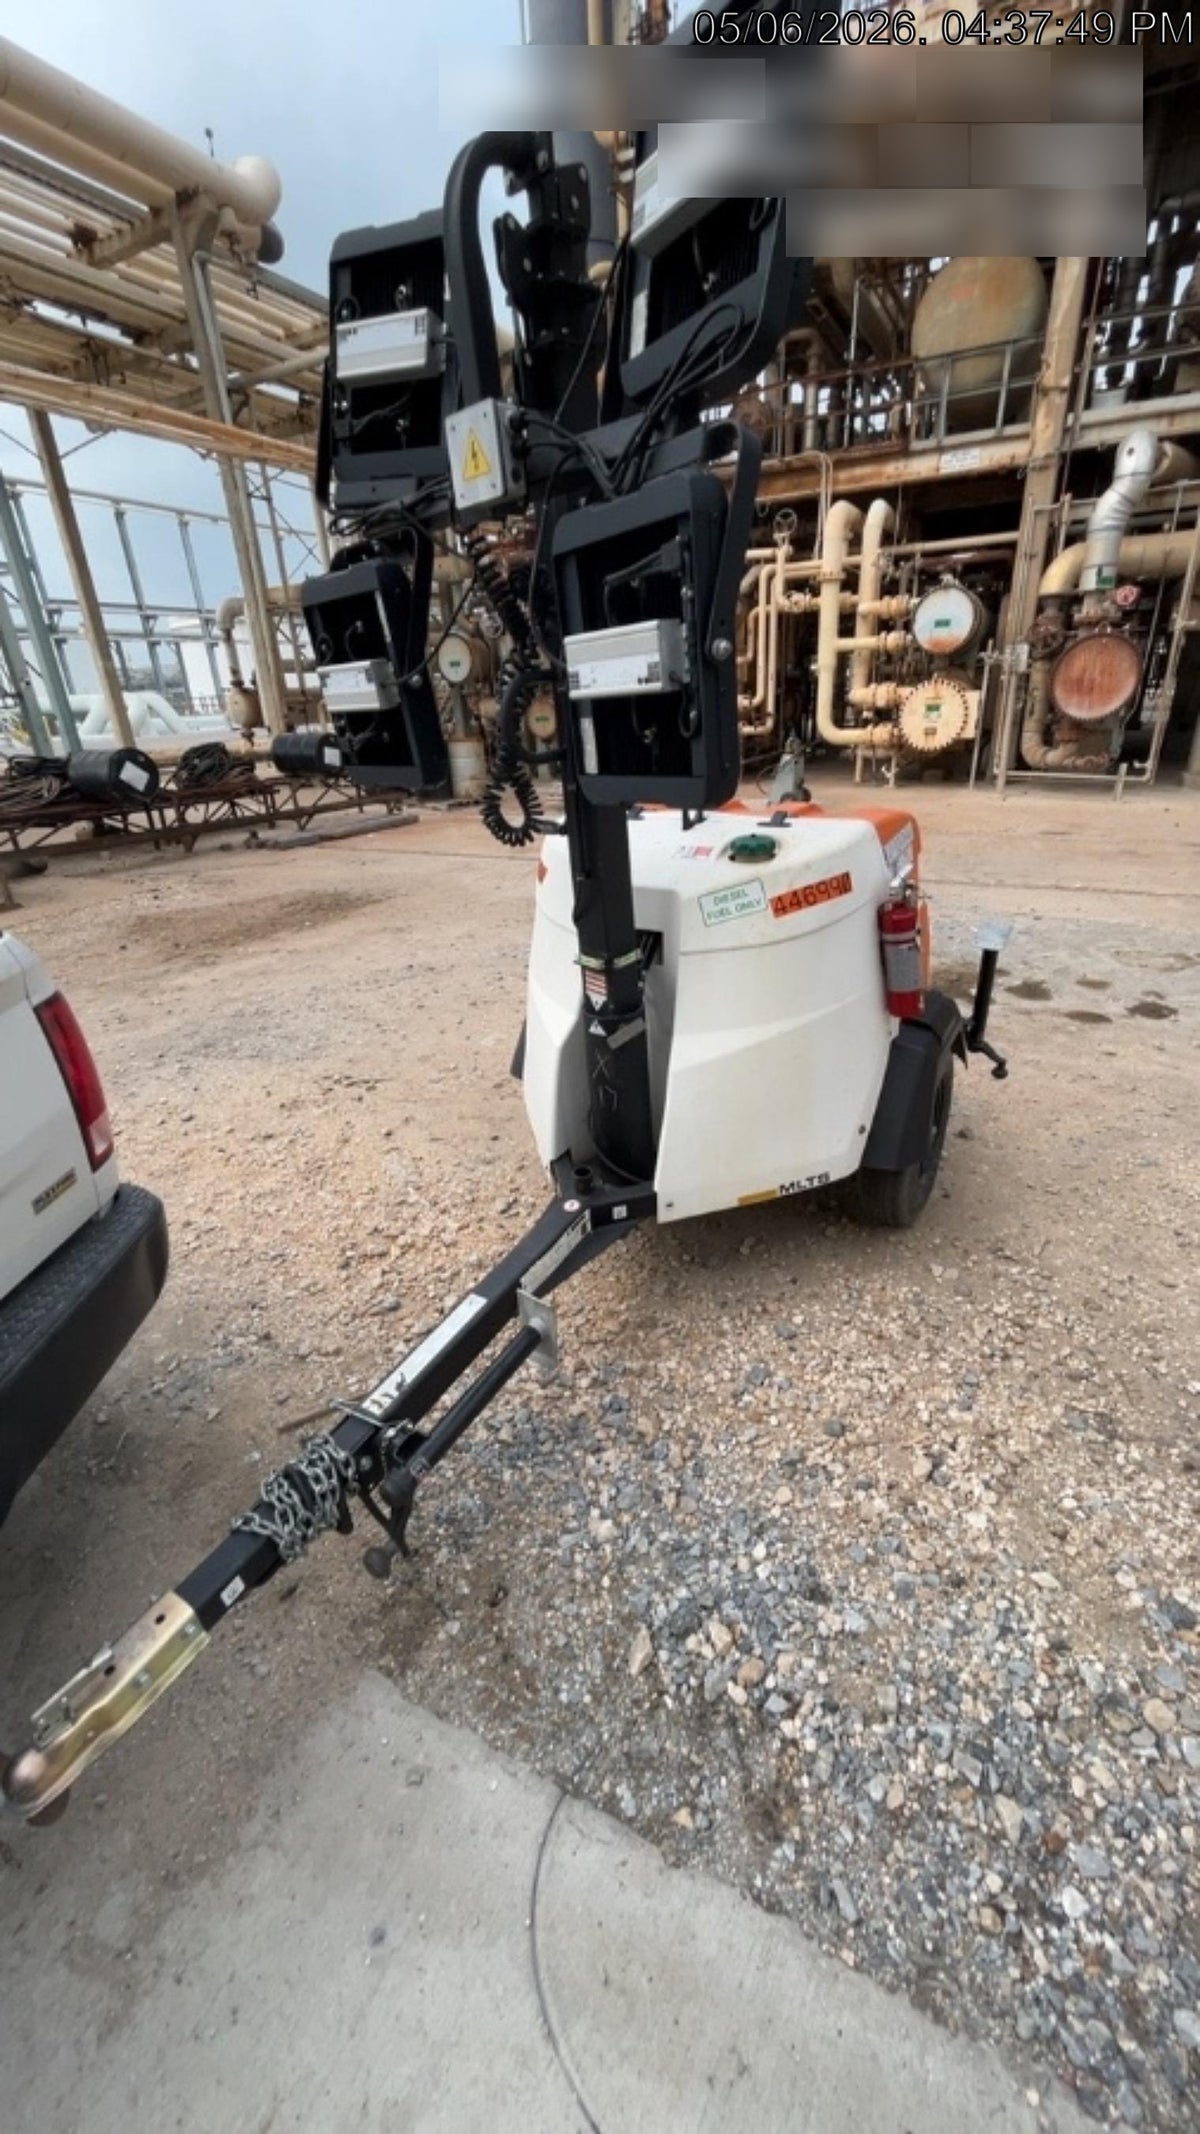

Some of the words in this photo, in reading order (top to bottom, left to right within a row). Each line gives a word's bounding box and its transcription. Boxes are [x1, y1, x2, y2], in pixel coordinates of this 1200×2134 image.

[713, 889, 749, 906] DIESEL
[707, 906, 733, 921] FUEL
[735, 899, 762, 915] ONLY
